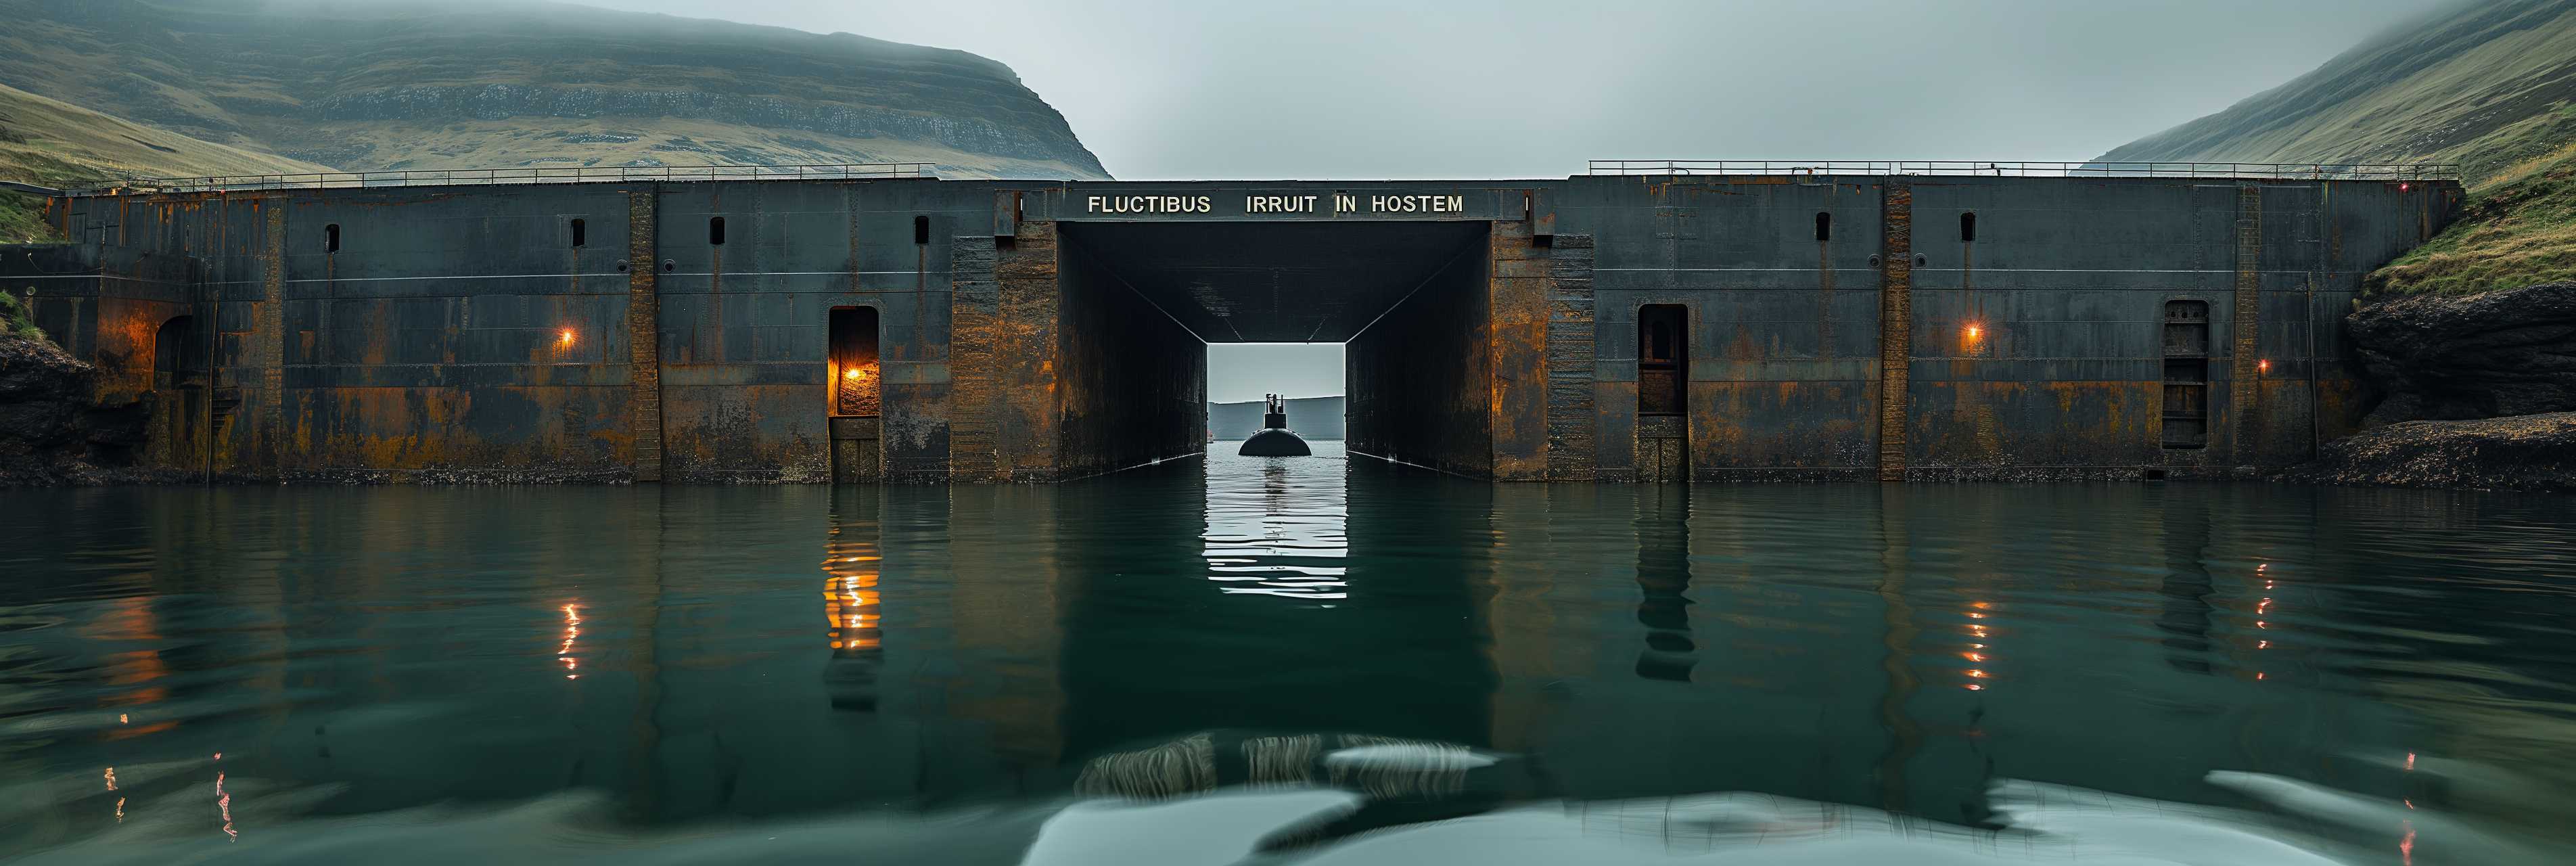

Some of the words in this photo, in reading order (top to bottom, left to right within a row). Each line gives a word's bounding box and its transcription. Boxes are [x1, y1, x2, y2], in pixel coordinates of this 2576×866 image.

[1087, 196, 1212, 213] FLUCTIBUS
[1245, 195, 1318, 212] IRRUIT
[1335, 195, 1356, 212] IN
[1371, 195, 1463, 212] HOSTEM
